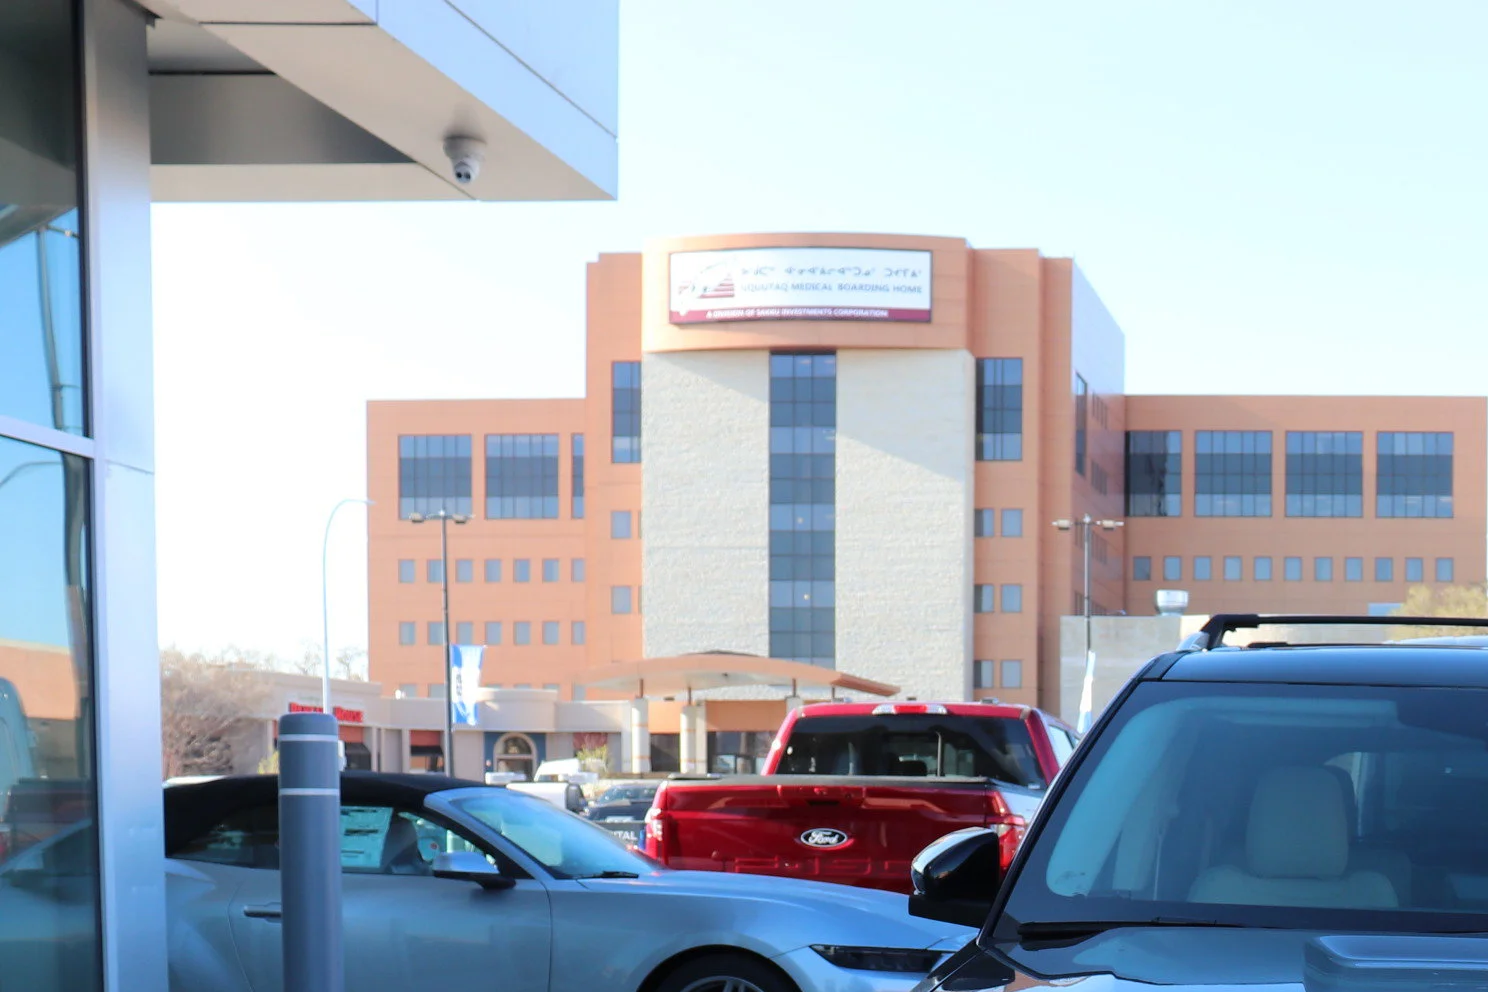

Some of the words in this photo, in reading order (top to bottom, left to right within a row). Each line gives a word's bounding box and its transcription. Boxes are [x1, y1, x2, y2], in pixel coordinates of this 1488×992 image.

[791, 282, 832, 291] MEDICAL
[838, 282, 890, 292] BOARDING
[893, 284, 922, 293] HOME
[808, 830, 839, 845] Ford
